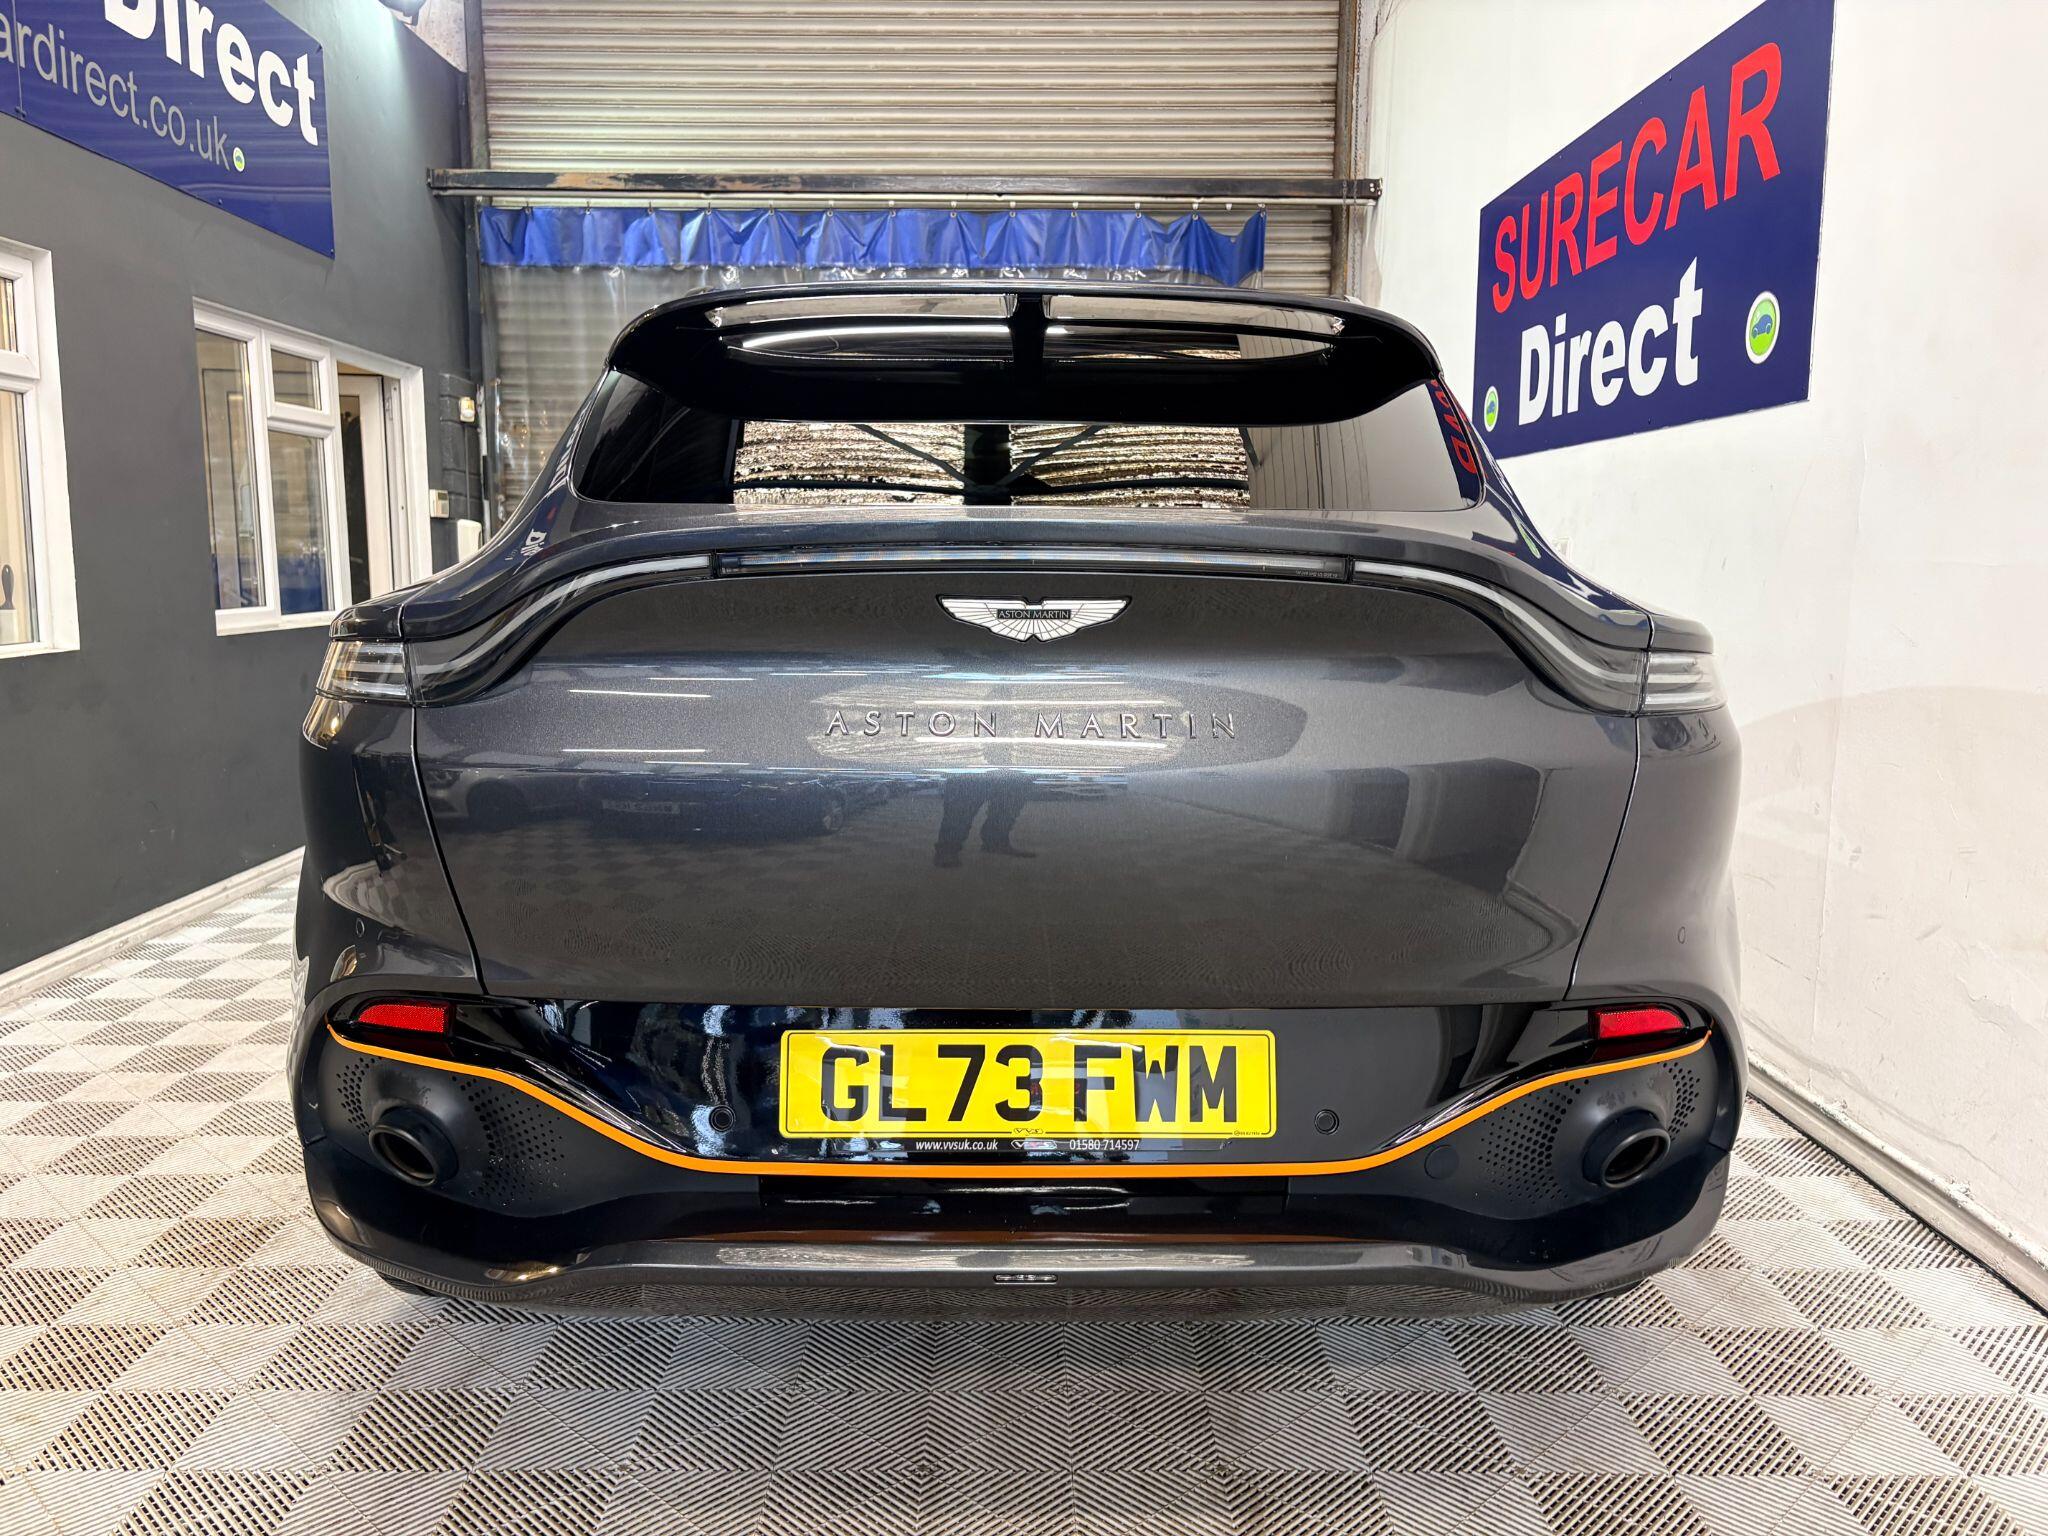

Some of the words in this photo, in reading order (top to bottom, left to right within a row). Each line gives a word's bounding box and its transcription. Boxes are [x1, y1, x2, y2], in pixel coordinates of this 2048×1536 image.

[104, 0, 318, 146] irect
[1492, 42, 1781, 313] SURECAR
[1518, 256, 1703, 426] Direct
[998, 610, 1031, 619] ASTON
[1032, 610, 1069, 619] MARTIN
[825, 710, 997, 737] ASTON
[1034, 711, 1236, 740] MARTIN
[820, 1044, 1044, 1122] GL73
[1073, 1044, 1237, 1123] FWM
[915, 1139, 998, 1151] www.vvsuk.co.uk
[1069, 1139, 1101, 1150] 01580
[1103, 1139, 1140, 1150] 714597
